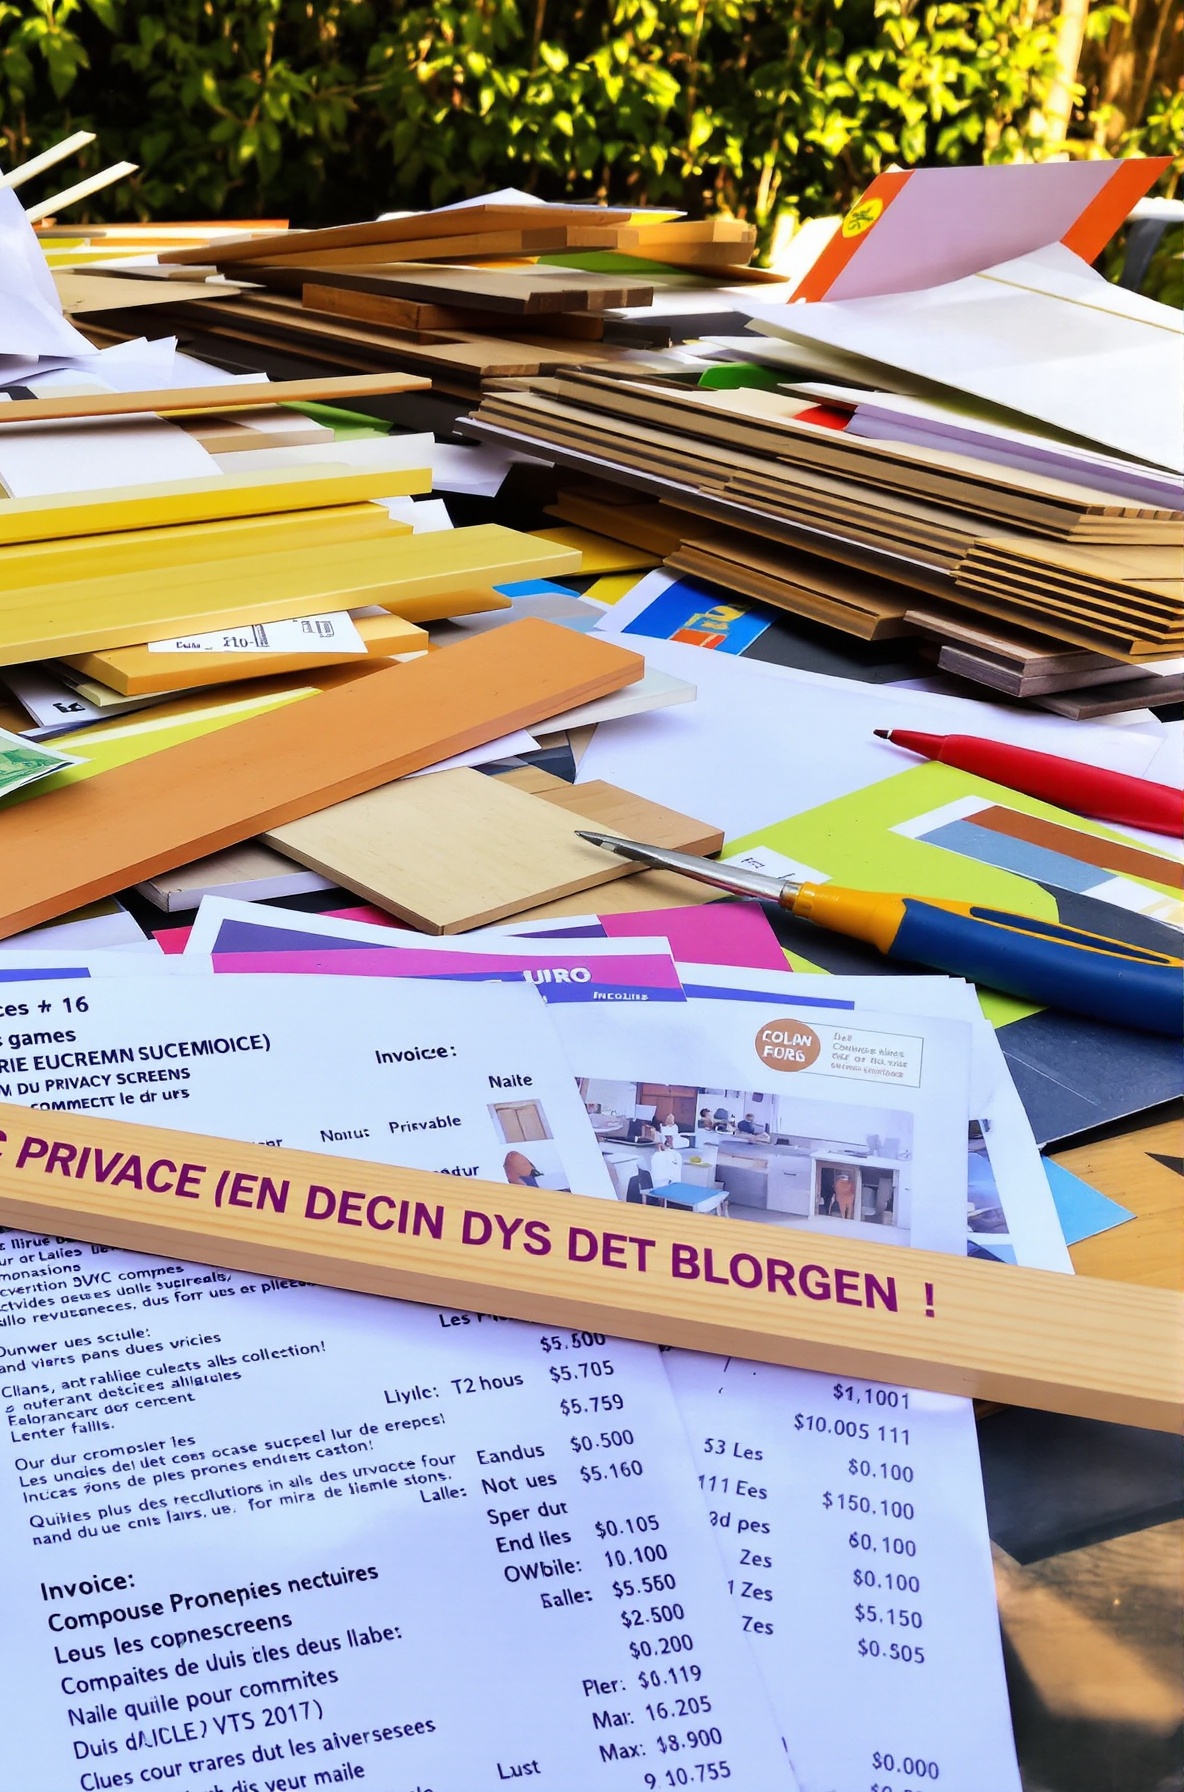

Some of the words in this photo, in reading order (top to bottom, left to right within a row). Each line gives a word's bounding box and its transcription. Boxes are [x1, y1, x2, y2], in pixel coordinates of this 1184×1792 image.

[62, 996, 90, 1014] 16
[8, 1029, 77, 1050] games
[33, 1047, 135, 1071] EUCREMN
[45, 1074, 112, 1092] PRIVACY
[116, 1067, 192, 1086] SCREENS
[15, 1135, 207, 1199] PRIVACE
[214, 1169, 291, 1214] (EN
[304, 1184, 445, 1244] DECIN
[461, 1210, 552, 1256] DYS
[568, 1226, 656, 1272] DET
[672, 1243, 899, 1313] BLORGEN
[923, 1282, 936, 1318] !
[439, 1313, 471, 1328] Les
[81, 1349, 120, 1364] pans
[125, 1342, 164, 1356] dues
[480, 1373, 524, 1391] hous
[548, 1360, 615, 1384] $5.705
[560, 1393, 624, 1416] $5.759
[476, 1444, 545, 1466] Eandus
[570, 1429, 635, 1453] $0.500
[878, 1425, 910, 1445] 111
[14, 1457, 45, 1472] Our
[50, 1453, 77, 1467] dur
[19, 1474, 48, 1488] Les
[359, 1423, 379, 1436] de
[733, 1442, 764, 1461] Les
[98, 1504, 132, 1520] plus
[138, 1498, 168, 1512] des
[319, 1469, 348, 1483] des
[421, 1454, 457, 1468] four
[127, 1475, 146, 1488] de
[481, 1478, 519, 1495] Not
[526, 1472, 558, 1489] ues
[580, 1459, 644, 1483] $5.160
[736, 1480, 768, 1500] Ees
[248, 1498, 273, 1512] for
[324, 1485, 343, 1499] de
[486, 1507, 530, 1527] Sper
[737, 1517, 771, 1535] pes
[495, 1532, 534, 1554] End
[594, 1514, 660, 1540] $0.105
[604, 1544, 668, 1568] 10.100
[739, 1548, 772, 1568] Zes
[853, 1568, 920, 1593] $0.100
[40, 1571, 136, 1602] Invoice:
[48, 1600, 165, 1633] Compouse
[287, 1564, 379, 1594] nectuires
[620, 1603, 685, 1629] $2.500
[741, 1581, 773, 1602] Zes
[854, 1602, 923, 1629] $5.150
[114, 1636, 145, 1656] les
[629, 1634, 694, 1660] $0.200
[741, 1615, 774, 1636] Zes
[857, 1637, 925, 1665] $0.505
[60, 1664, 169, 1696] Compaites
[174, 1657, 199, 1678] de
[296, 1637, 342, 1658] deus
[638, 1664, 702, 1690] $0.119
[68, 1703, 118, 1727] Naile
[186, 1686, 233, 1712] pour
[646, 1695, 712, 1722] 16.205
[73, 1737, 118, 1760] Duis
[213, 1712, 256, 1736] VTS
[262, 1699, 324, 1728] 2017)
[80, 1772, 134, 1792] Clues
[140, 1763, 183, 1781] cour
[290, 1738, 317, 1758] les
[599, 1743, 646, 1762] Max:
[872, 1751, 939, 1780] $0.000
[314, 1762, 366, 1785] maile
